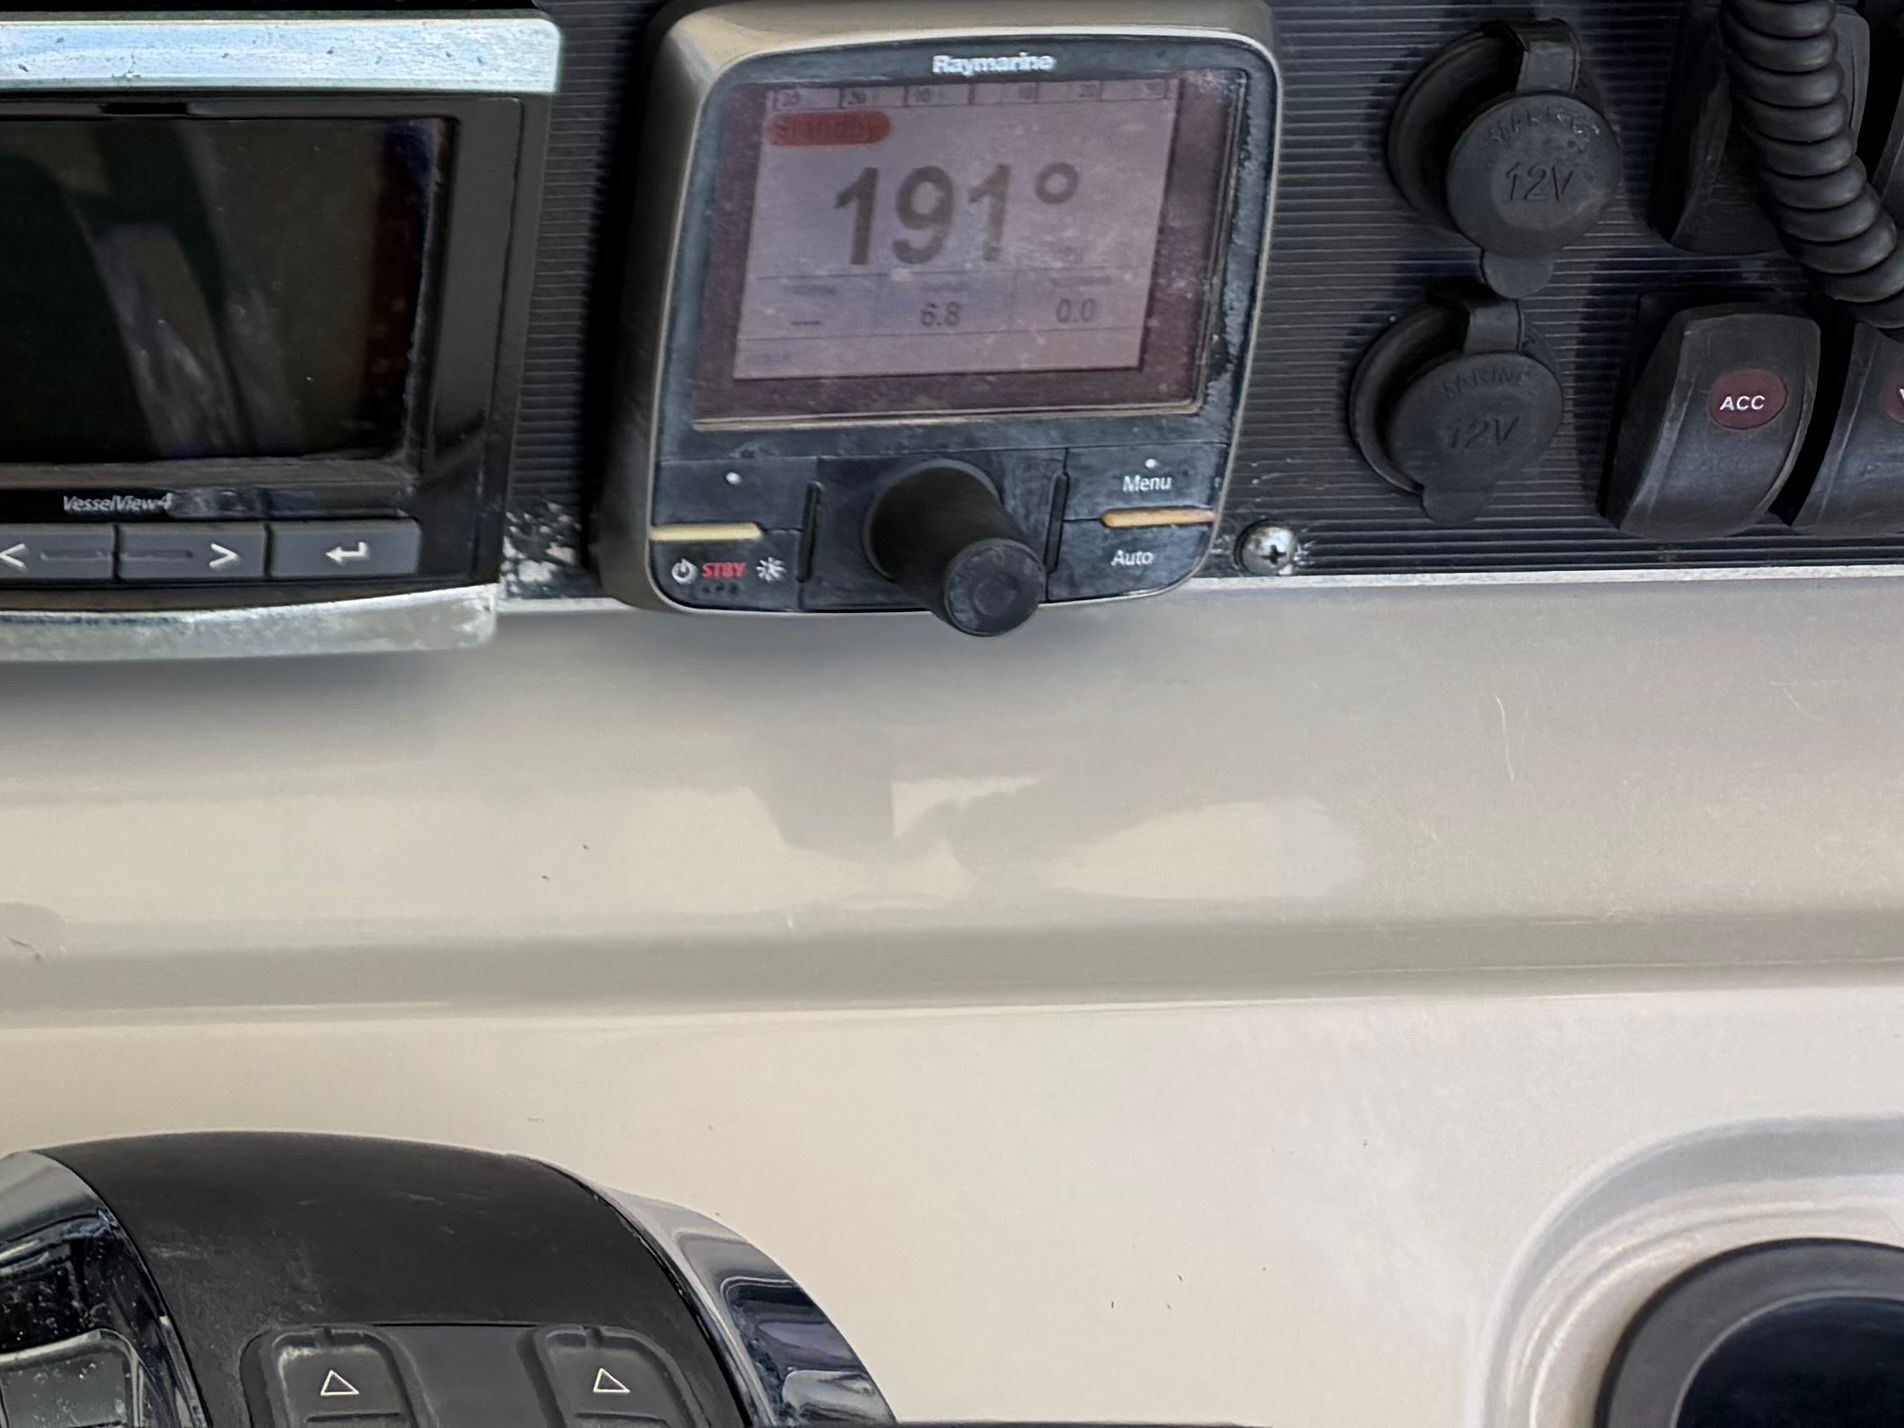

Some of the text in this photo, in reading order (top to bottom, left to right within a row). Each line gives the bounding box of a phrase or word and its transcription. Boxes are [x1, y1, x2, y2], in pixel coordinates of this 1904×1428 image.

[932, 52, 1055, 76] Raymarine
[1506, 162, 1575, 202] 12V
[833, 161, 1080, 266] 191°
[919, 300, 962, 328] 6.8
[1055, 297, 1097, 324] 0.0
[1719, 394, 1766, 411] ACC
[1122, 473, 1172, 493] Menu
[1110, 548, 1154, 568] Auto
[702, 562, 747, 580] STBY
